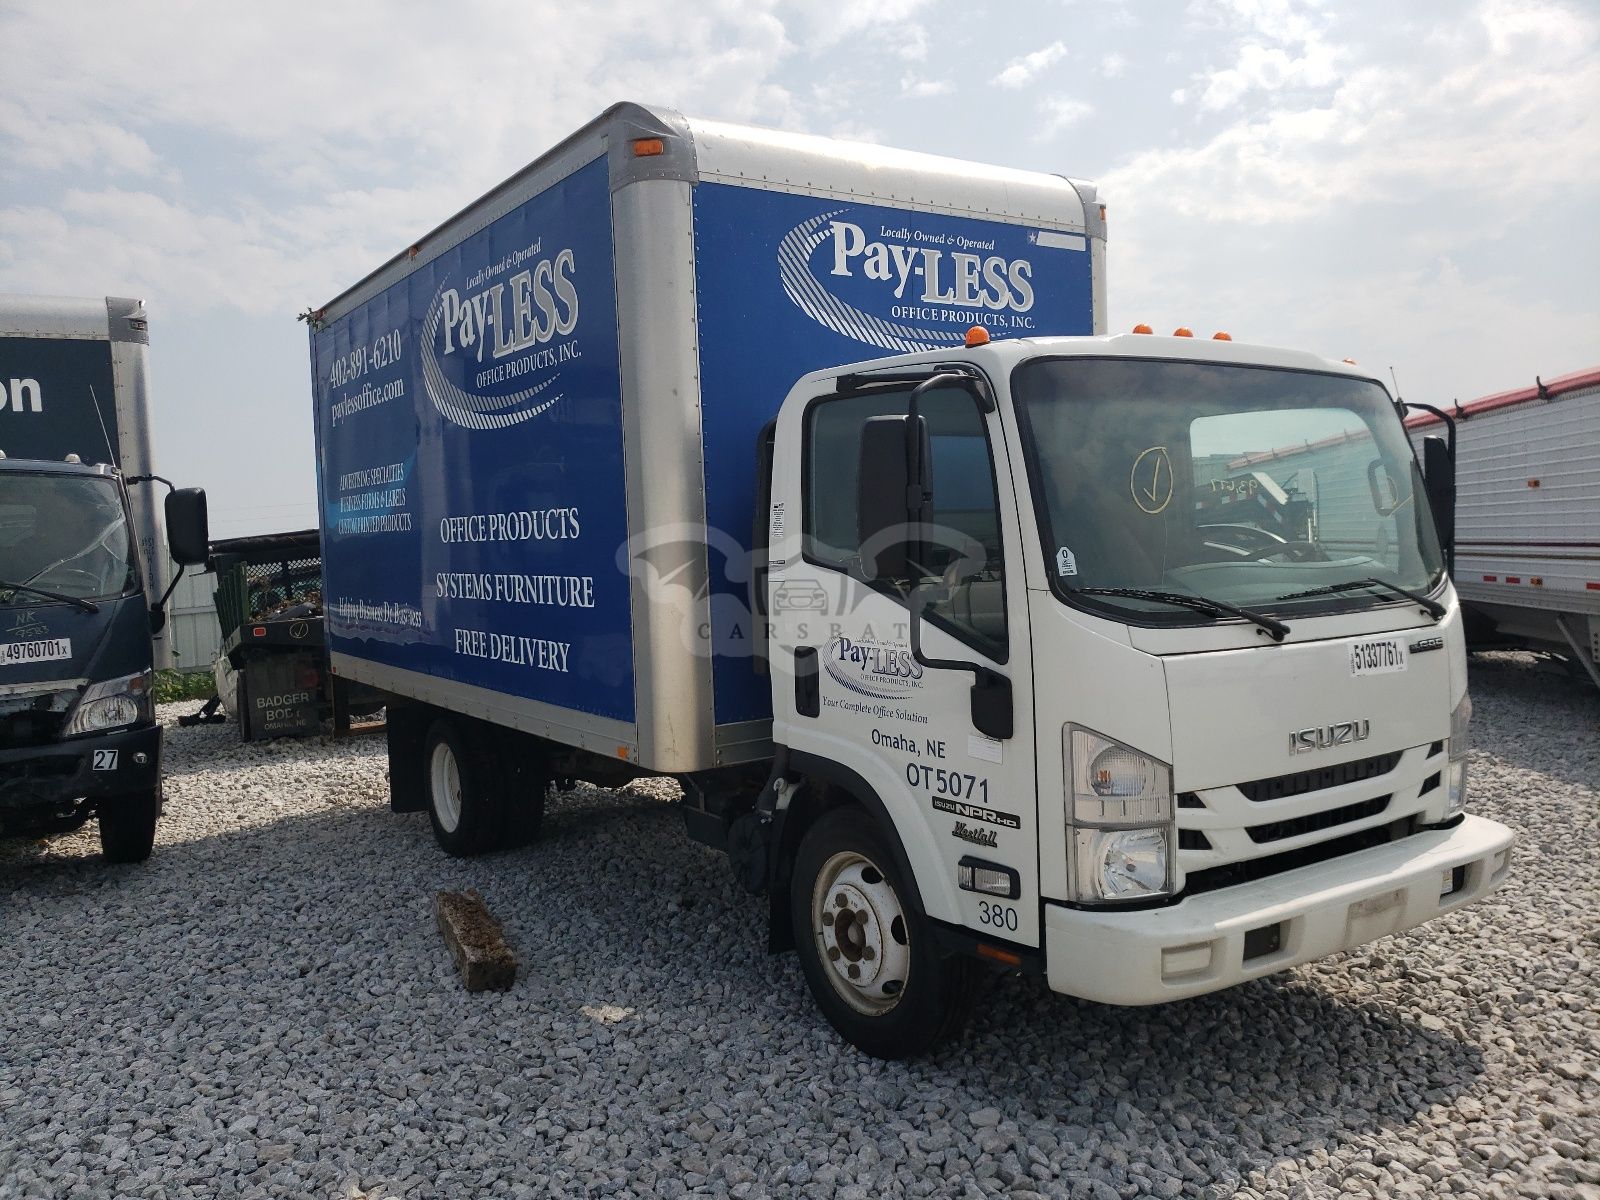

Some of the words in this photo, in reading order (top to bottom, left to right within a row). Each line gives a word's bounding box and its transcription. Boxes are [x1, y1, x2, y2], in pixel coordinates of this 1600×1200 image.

[880, 225, 913, 243] Locally
[914, 230, 945, 245] Owned
[946, 234, 955, 244] &
[956, 235, 995, 251] Operated
[466, 269, 485, 290] Locally
[485, 256, 506, 279] Owned
[512, 236, 541, 267] Operated
[829, 220, 1035, 313] Pay-LESS
[441, 248, 579, 362] Pay-LESS
[891, 305, 939, 321] OFFICE
[941, 309, 1008, 328] PRODUCTS,
[1011, 315, 1036, 329] INC.
[329, 328, 401, 389] 402-891-6210
[476, 365, 505, 389] OFFICE
[506, 350, 558, 383] PRODUCTS,
[559, 339, 583, 364] INC.
[0, 379, 42, 411] n
[331, 378, 405, 428] paylessoffice.com
[385, 487, 406, 508] LABELS
[380, 512, 412, 532] PRODUCTS
[440, 515, 487, 543] OFFICE
[489, 507, 580, 542] PRODUCTS
[436, 572, 493, 601] SYSTEMS
[495, 574, 595, 608] FURNITURE
[455, 628, 488, 659] FREE
[490, 632, 570, 673] DELIVERY
[839, 636, 923, 680] Pay-LESS
[256, 692, 309, 709] BADGER
[823, 696, 838, 707] Your
[839, 700, 872, 715] Complete
[872, 705, 894, 719] Office
[895, 709, 928, 724] Solution
[871, 728, 921, 757] Omaha,
[927, 740, 946, 759] NE
[1289, 718, 1370, 756] ISUZU
[94, 750, 118, 770] 27
[906, 762, 989, 803] OT5071
[934, 800, 955, 811] ISUZU
[978, 900, 1018, 931] 380
